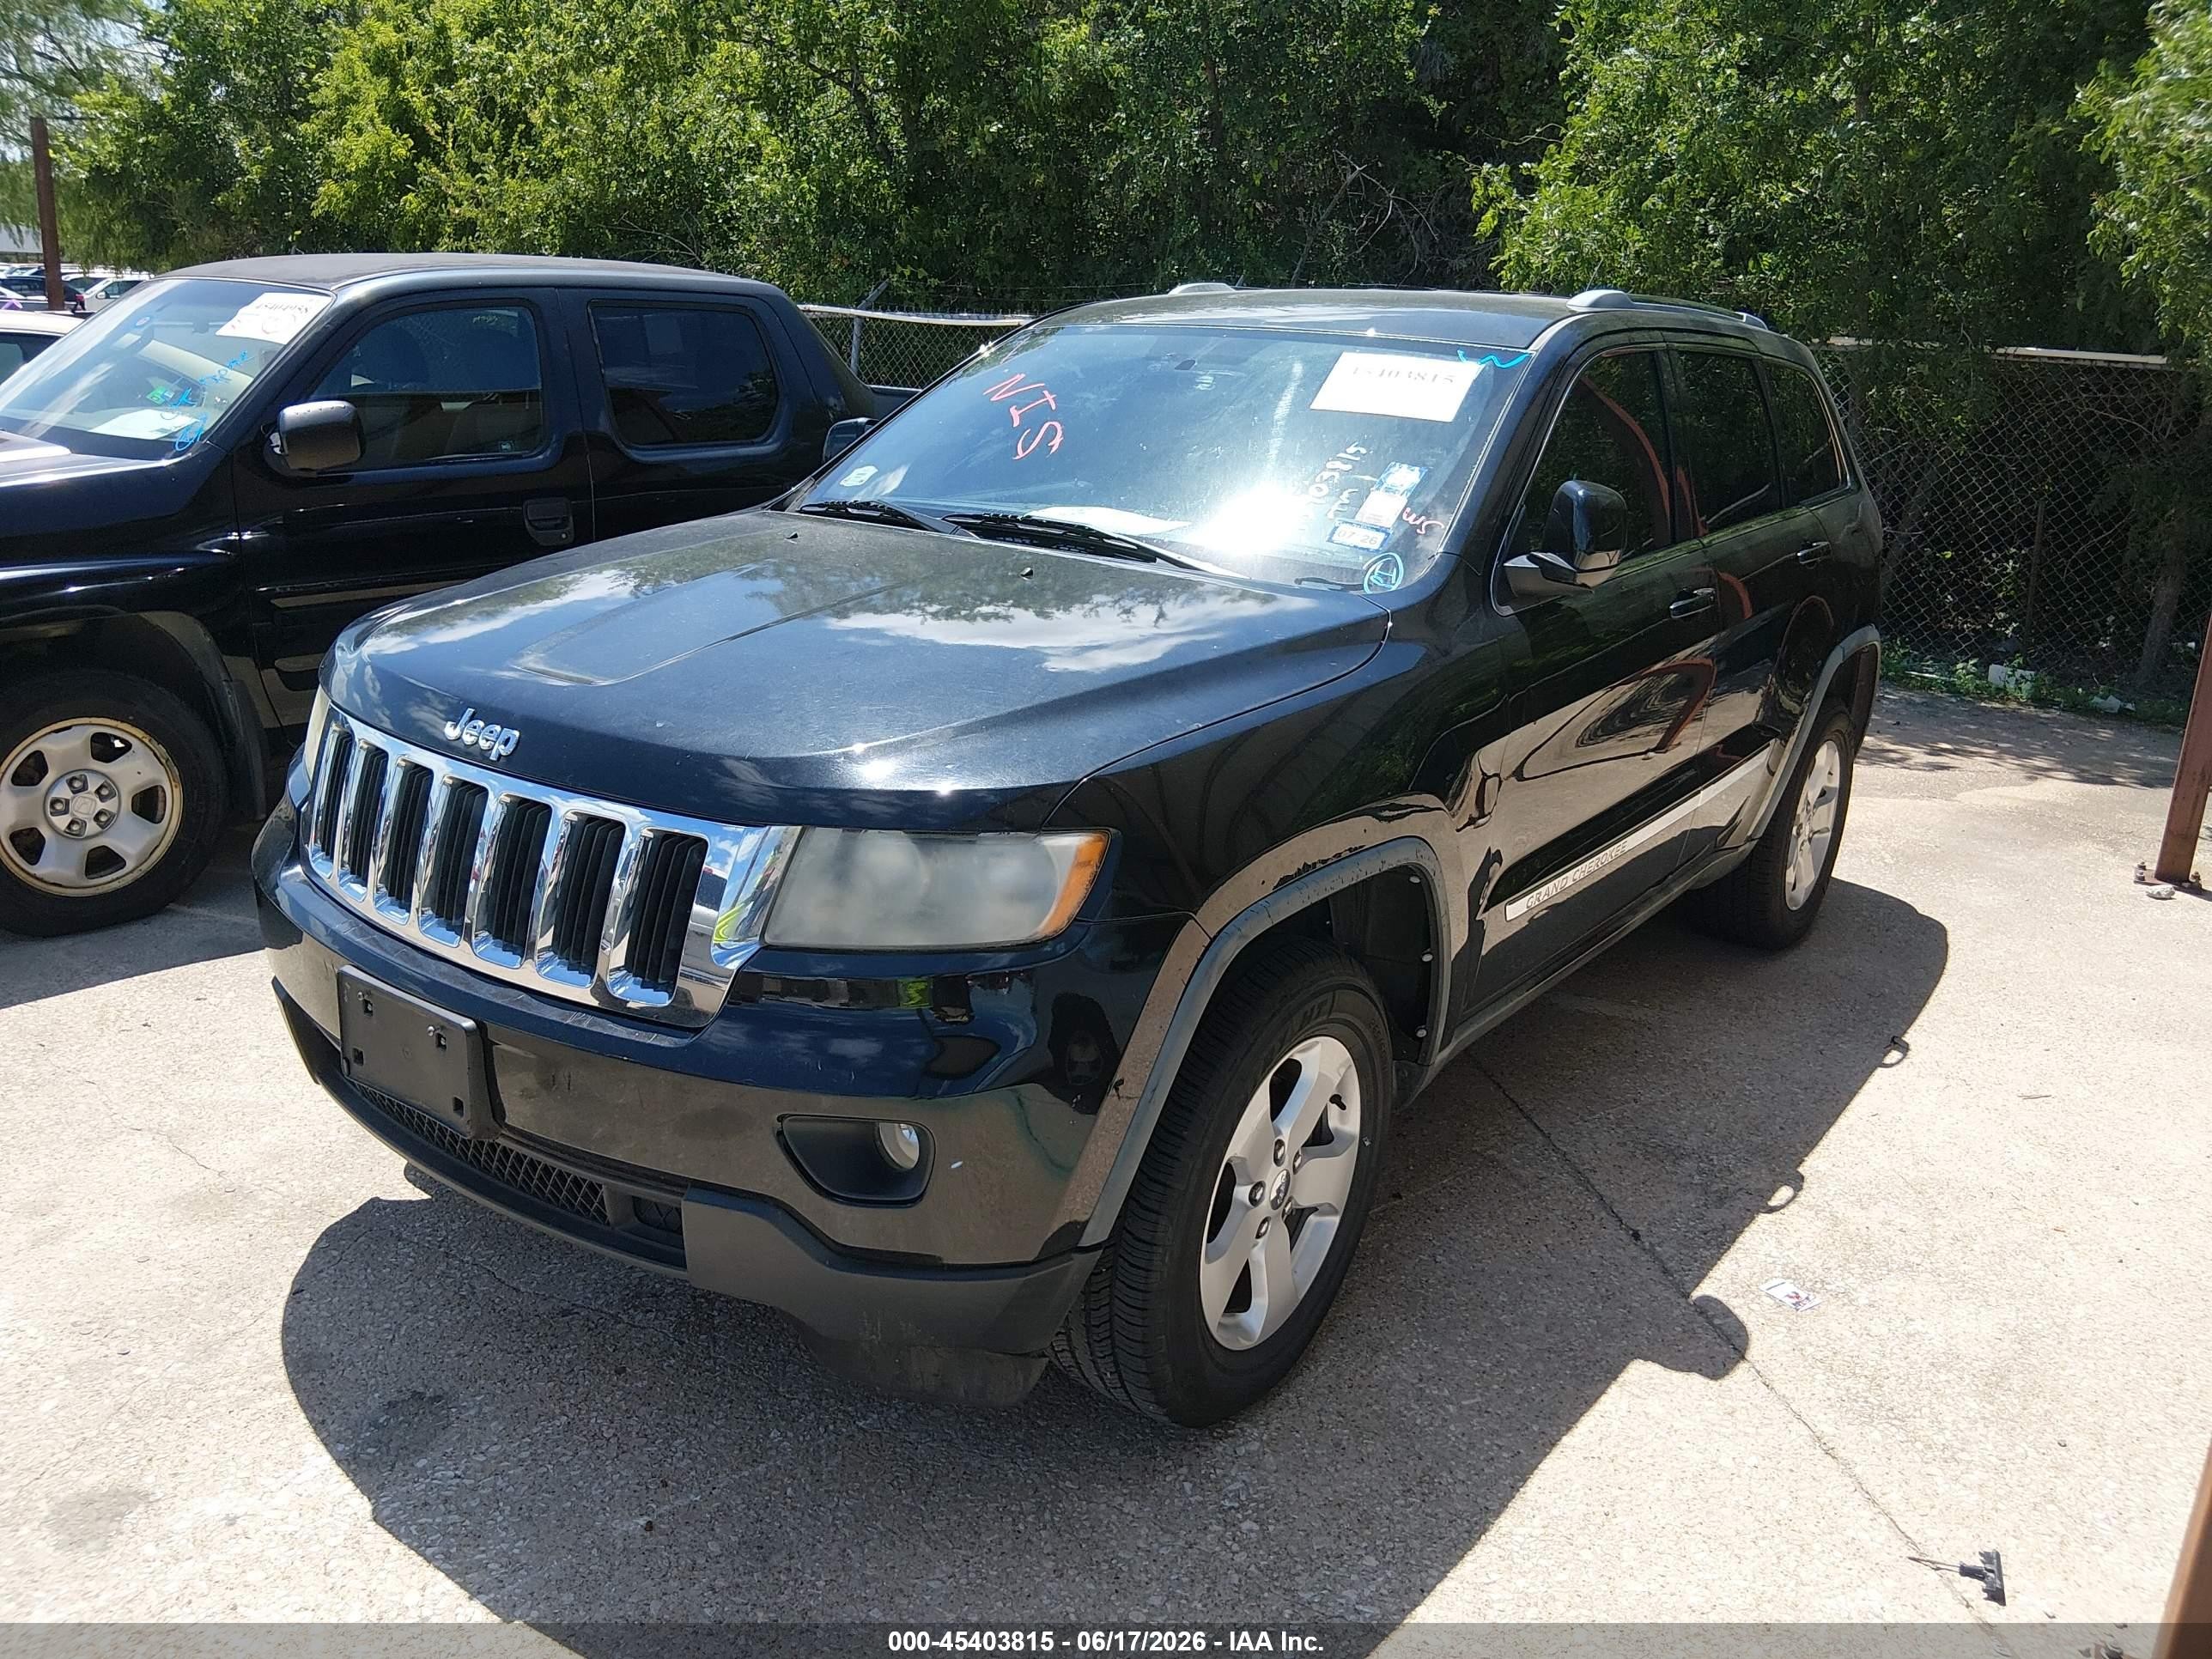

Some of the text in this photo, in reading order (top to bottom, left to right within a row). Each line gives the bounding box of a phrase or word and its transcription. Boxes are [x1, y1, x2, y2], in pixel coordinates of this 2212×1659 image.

[982, 373, 1064, 460] NIS
[444, 708, 520, 761] Jeep
[1525, 840, 1628, 909] GRAND CHEROKEE
